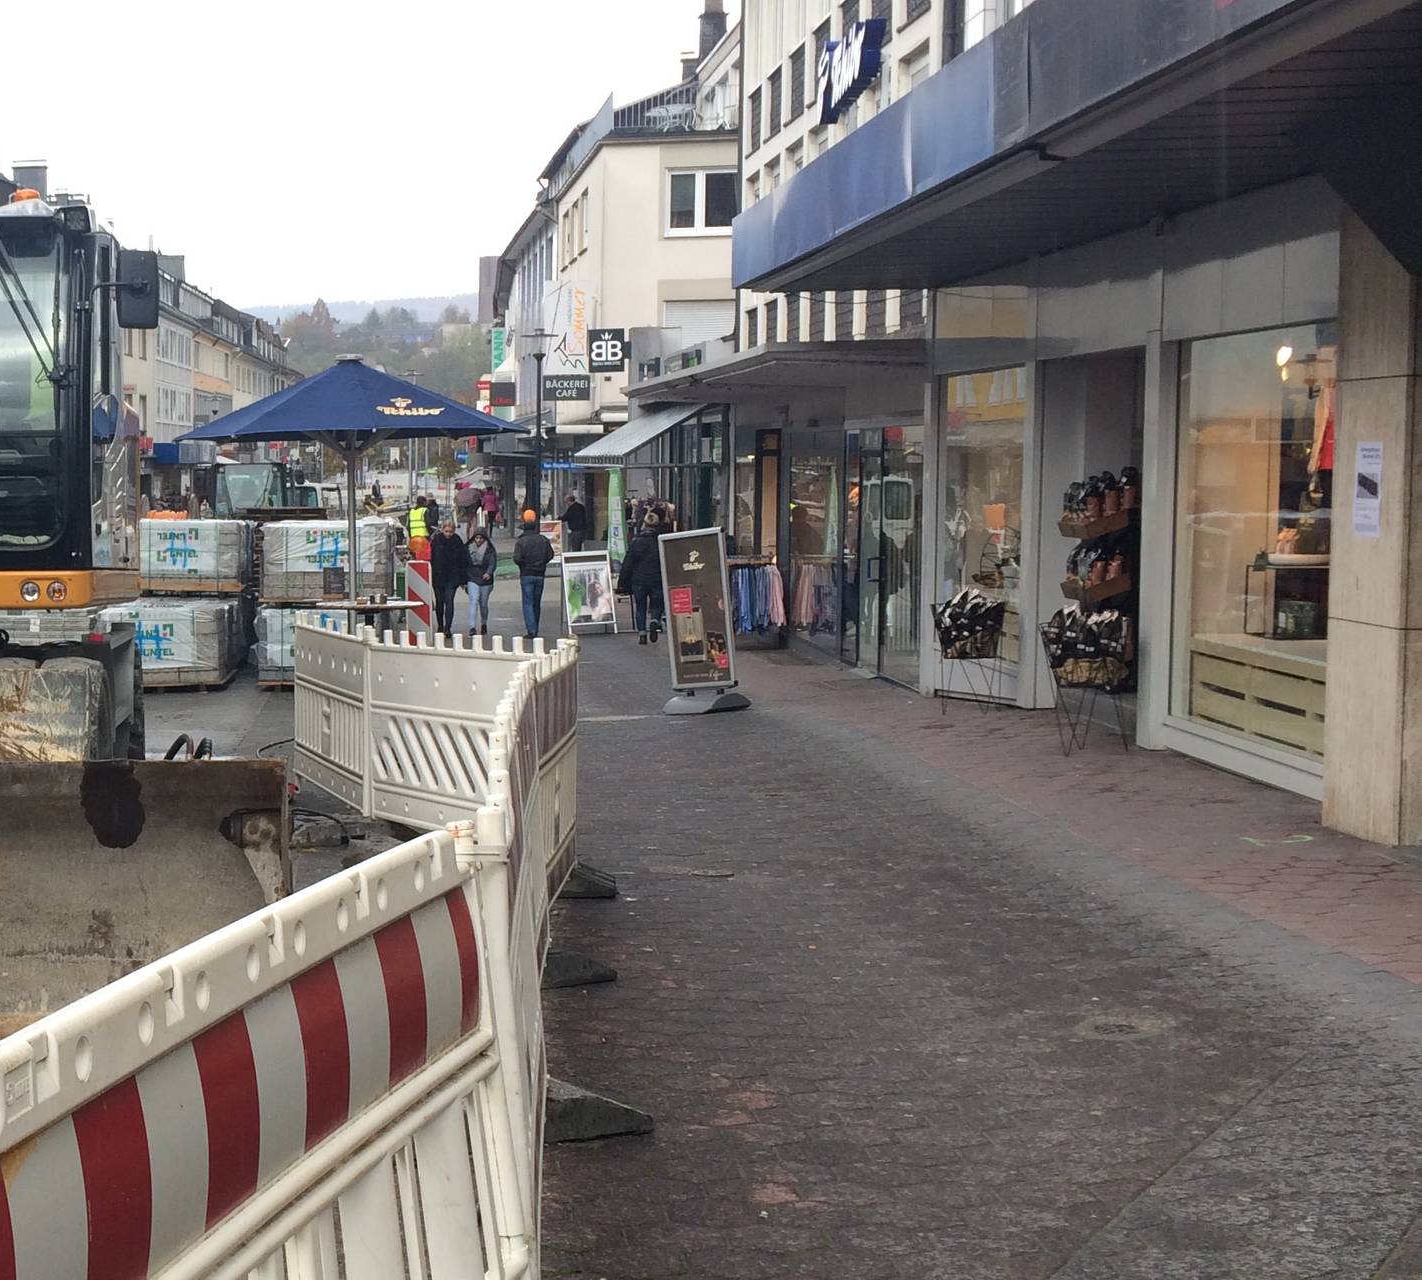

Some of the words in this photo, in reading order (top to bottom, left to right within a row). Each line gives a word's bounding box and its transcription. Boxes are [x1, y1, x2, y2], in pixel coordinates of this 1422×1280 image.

[545, 379, 588, 389] BÄCKEREI
[555, 389, 578, 398] CAFÉ
[375, 405, 445, 416] Tchibo
